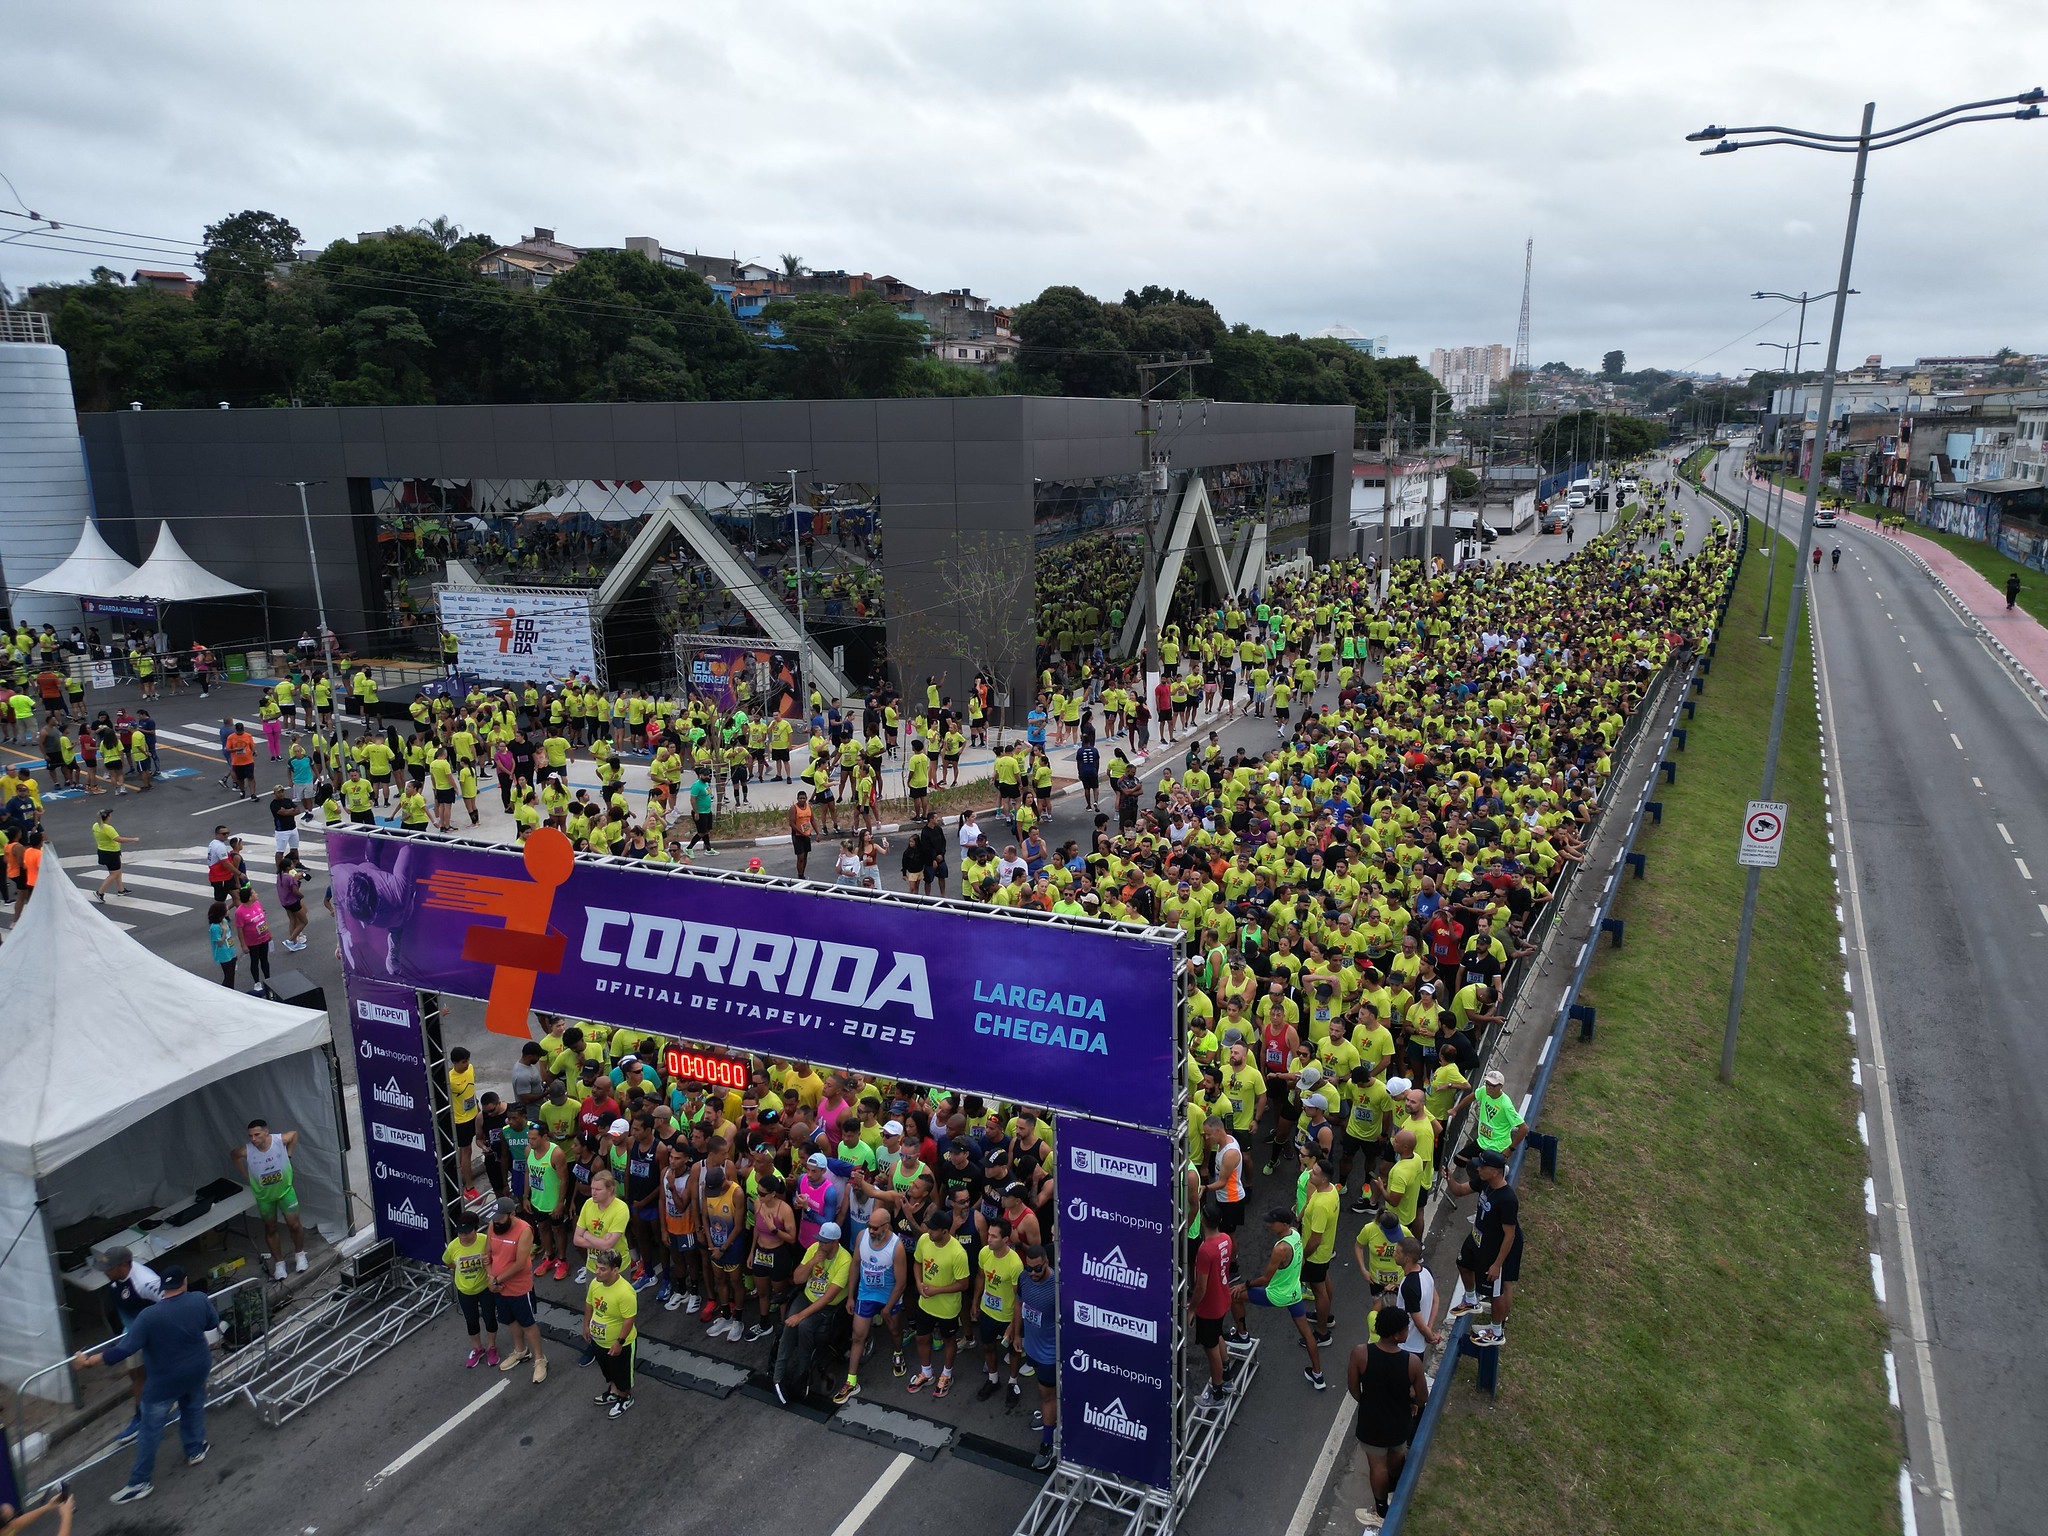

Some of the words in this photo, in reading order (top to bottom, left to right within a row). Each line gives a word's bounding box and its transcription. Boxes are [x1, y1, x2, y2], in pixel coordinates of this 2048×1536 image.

[515, 618, 535, 631] CO
[514, 630, 539, 643] RRI
[512, 642, 533, 655] DA
[693, 660, 711, 675] EU
[1751, 803, 1784, 811] ATENÇÃO
[580, 906, 934, 1020] CORRIDA
[973, 980, 1106, 1022] LARGADA
[374, 1007, 404, 1021] ITAPEVI
[595, 978, 683, 1005] OFICIAL
[690, 994, 719, 1011] DE
[724, 1000, 822, 1029] ITAPEVI
[842, 1019, 916, 1046] 2025
[974, 1011, 1109, 1056] CHEGADA
[373, 1046, 418, 1066] Itashopping
[1268, 1053, 1280, 1061] 449
[668, 1051, 744, 1087] 00:00:00
[373, 1082, 414, 1109] biomania
[389, 1130, 420, 1144] ITAPEVI
[634, 1165, 646, 1173] 237
[1100, 1157, 1148, 1177] ITAPEVI
[387, 1203, 429, 1229] biomania
[1091, 1206, 1163, 1234] Itashopping
[866, 1275, 881, 1284] 675
[1082, 1252, 1149, 1289] biomania
[1379, 1274, 1398, 1283] 1128
[809, 1281, 825, 1292] 1935
[986, 1297, 1000, 1307] 439
[1102, 1312, 1148, 1334] ITAPEVI
[1092, 1358, 1162, 1390] Itashopping
[1083, 1401, 1148, 1441] biomania
